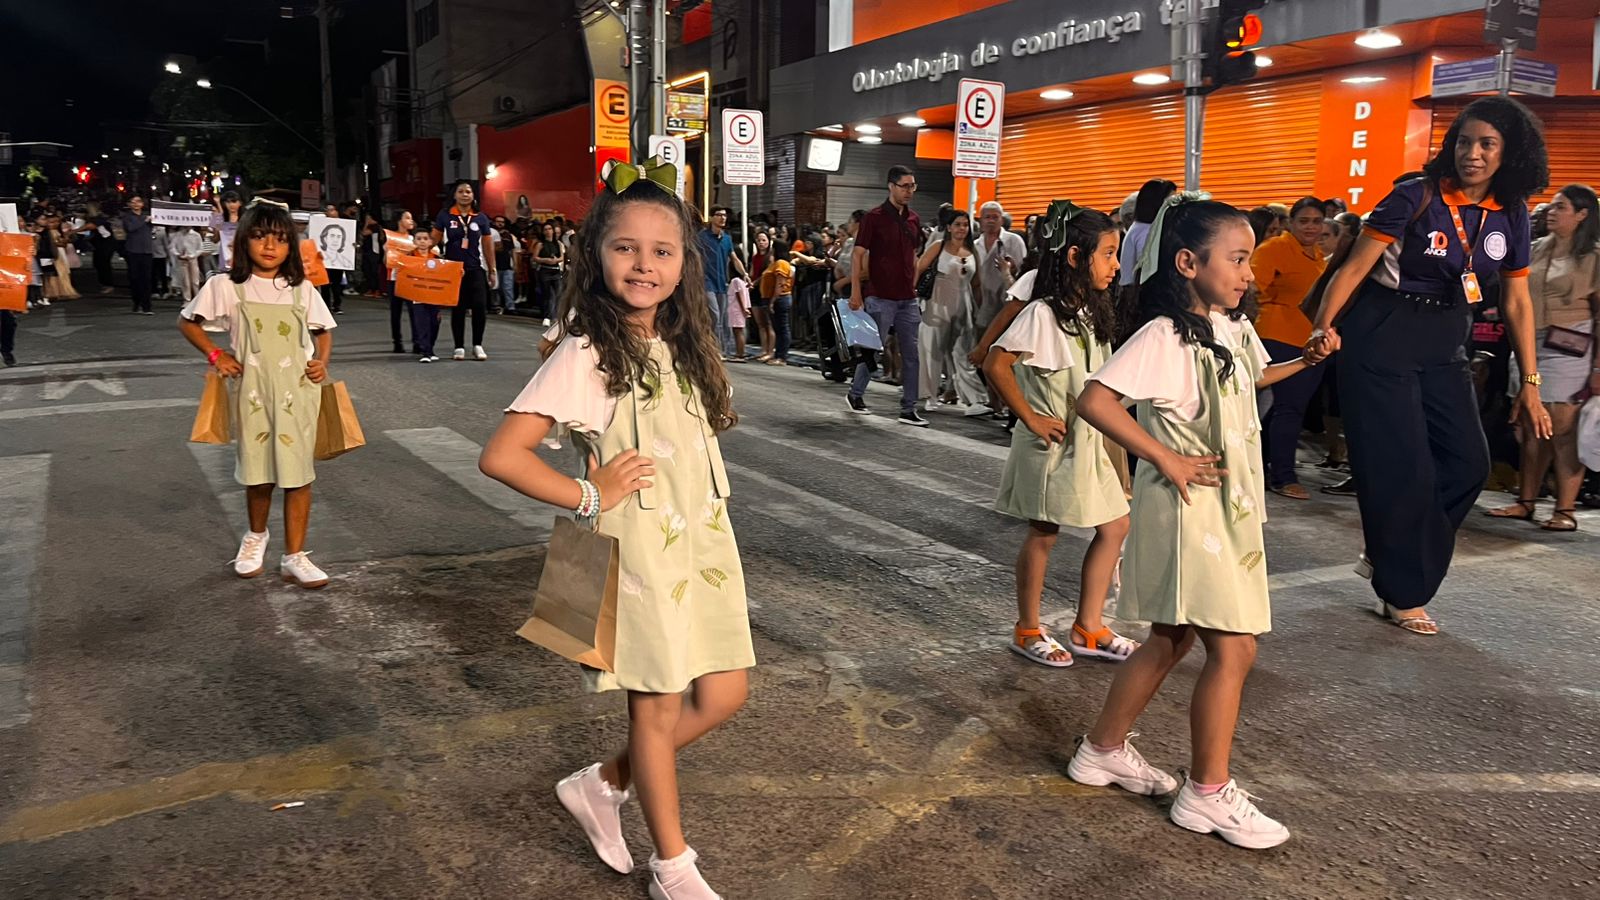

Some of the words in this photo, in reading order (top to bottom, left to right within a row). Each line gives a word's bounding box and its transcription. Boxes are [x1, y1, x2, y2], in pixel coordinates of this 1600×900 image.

[852, 51, 960, 93] Odontologia
[971, 42, 1000, 67] de
[1012, 11, 1142, 57] confiança
[608, 92, 625, 115] E
[975, 97, 985, 119] E
[738, 121, 747, 138] E
[663, 145, 671, 160] E
[1348, 101, 1371, 204] DENT
[1427, 230, 1449, 249] 10
[1424, 247, 1447, 257] ANOS
